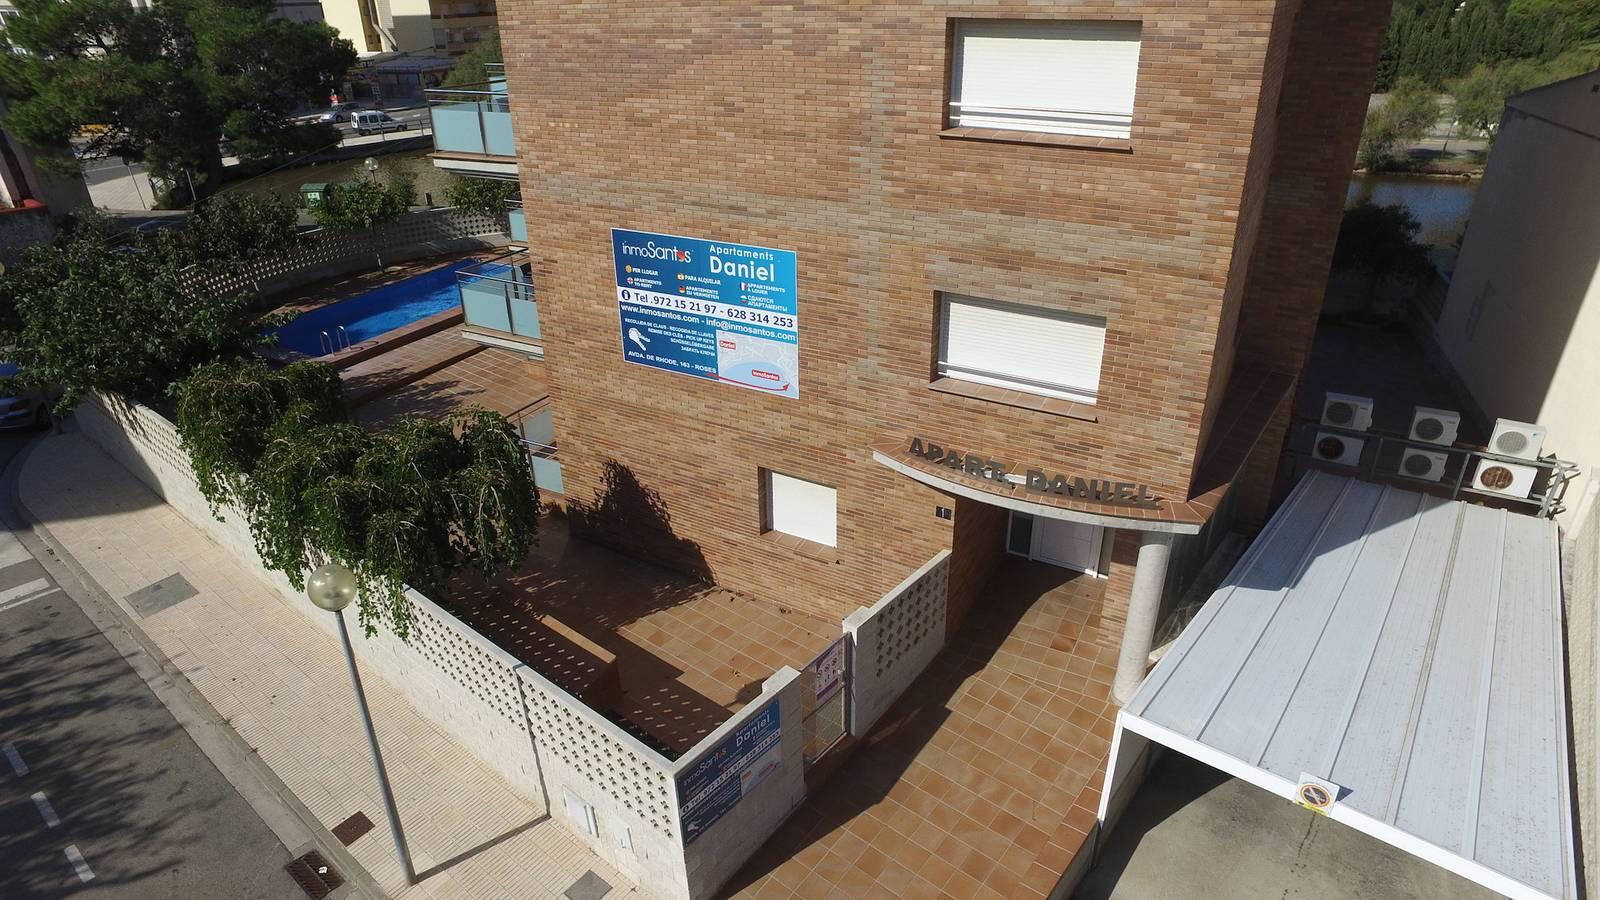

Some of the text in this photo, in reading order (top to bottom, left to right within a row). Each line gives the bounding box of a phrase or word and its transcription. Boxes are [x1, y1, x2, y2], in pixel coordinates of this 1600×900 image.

[709, 244, 774, 261] Apartaments
[710, 256, 775, 282] Daniel
[621, 305, 699, 324] www.inmosantos.com
[706, 318, 796, 342] info@inmosantos.com
[675, 299, 686, 309] 15
[689, 302, 701, 312] 21
[704, 304, 717, 314] 97
[727, 308, 746, 320] 628
[750, 312, 769, 324] 314
[773, 316, 793, 328] 253
[695, 365, 717, 374] ROSES
[1026, 468, 1157, 506] DANIEL
[736, 714, 770, 748] Daniel
